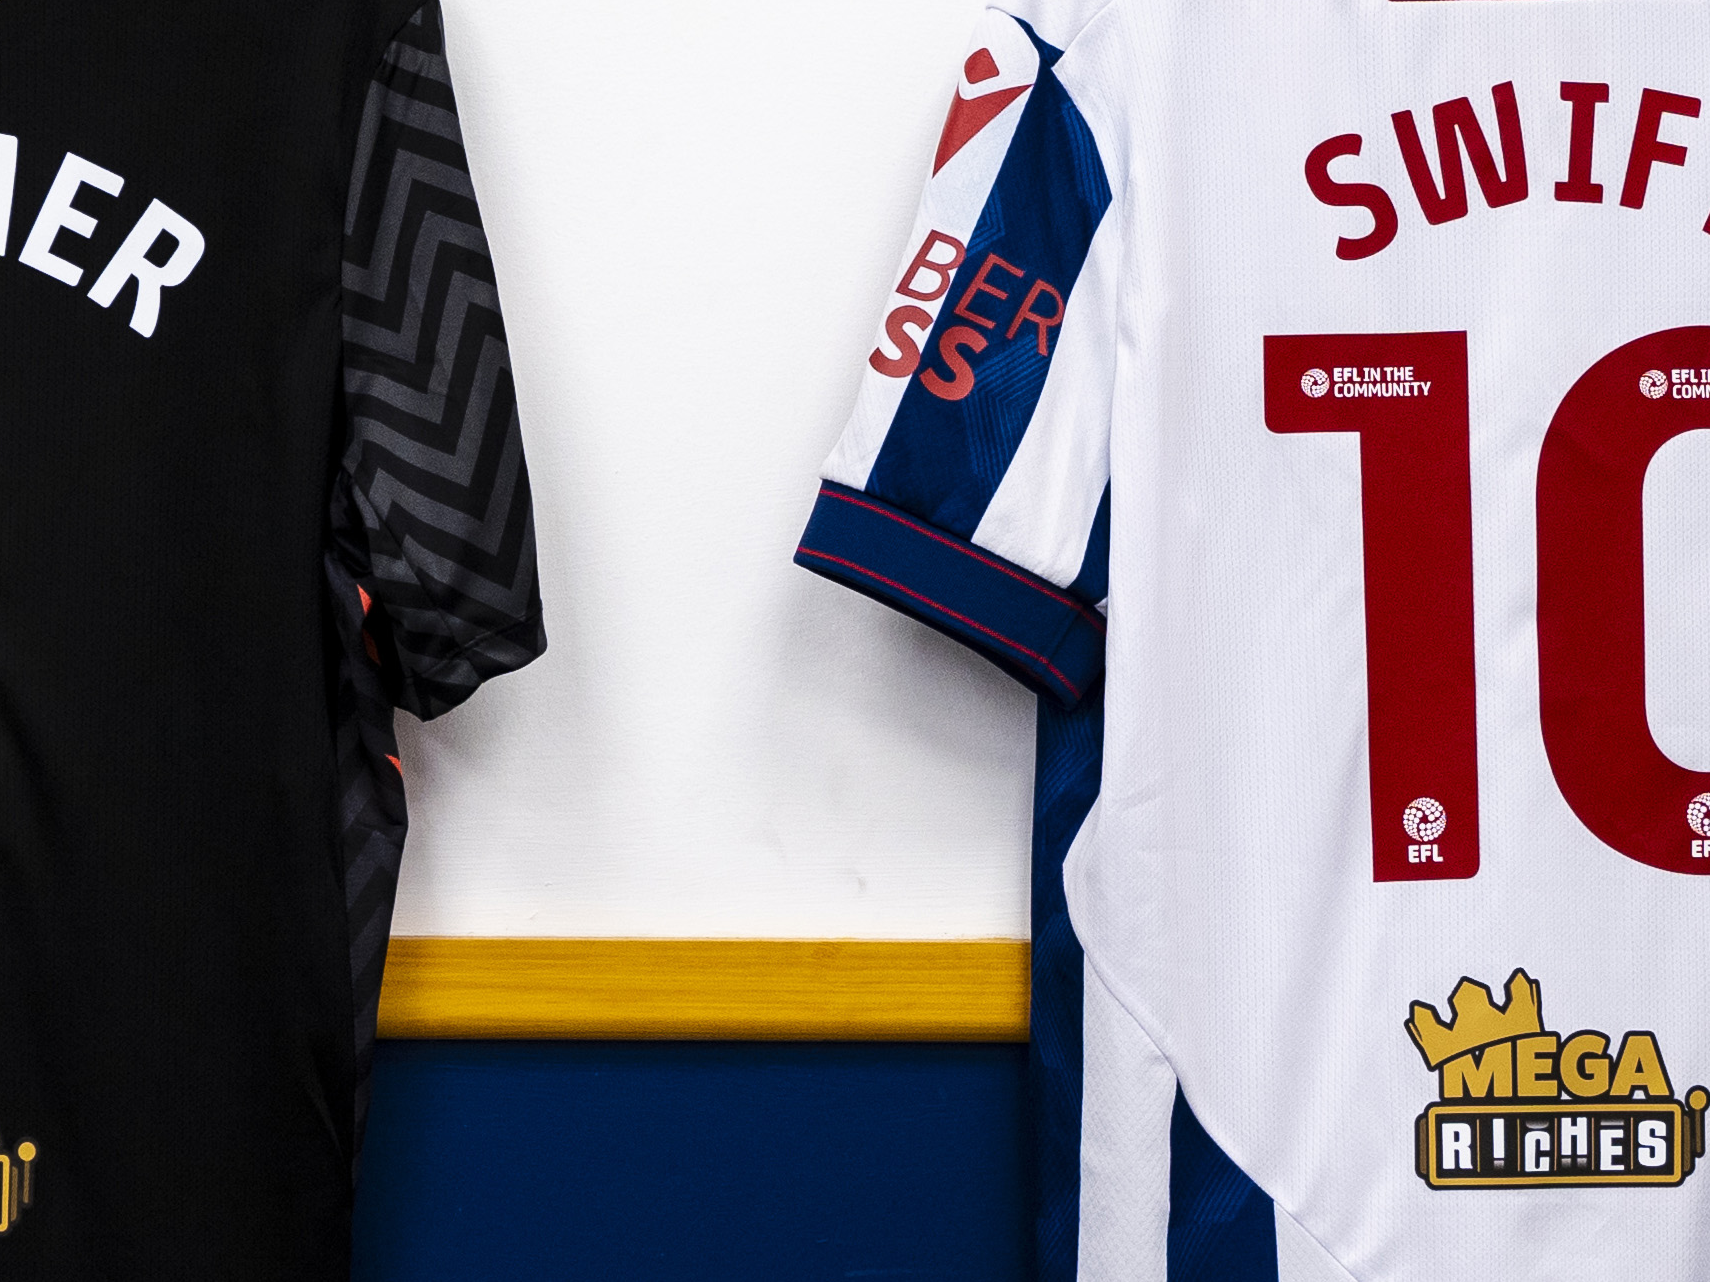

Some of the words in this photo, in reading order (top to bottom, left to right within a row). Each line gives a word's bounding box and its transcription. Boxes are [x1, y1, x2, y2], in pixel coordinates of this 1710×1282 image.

[895, 229, 1065, 356] BER
[868, 305, 989, 401] SS
[1333, 367, 1361, 382] EFL
[1363, 367, 1381, 382] IN
[1383, 366, 1414, 381] THE
[1334, 381, 1431, 398] COMMUNITY
[1671, 369, 1698, 383] EFL
[1408, 843, 1444, 863] EFL
[1443, 1034, 1670, 1098] MEGA
[1441, 1117, 1667, 1173] RICHES
